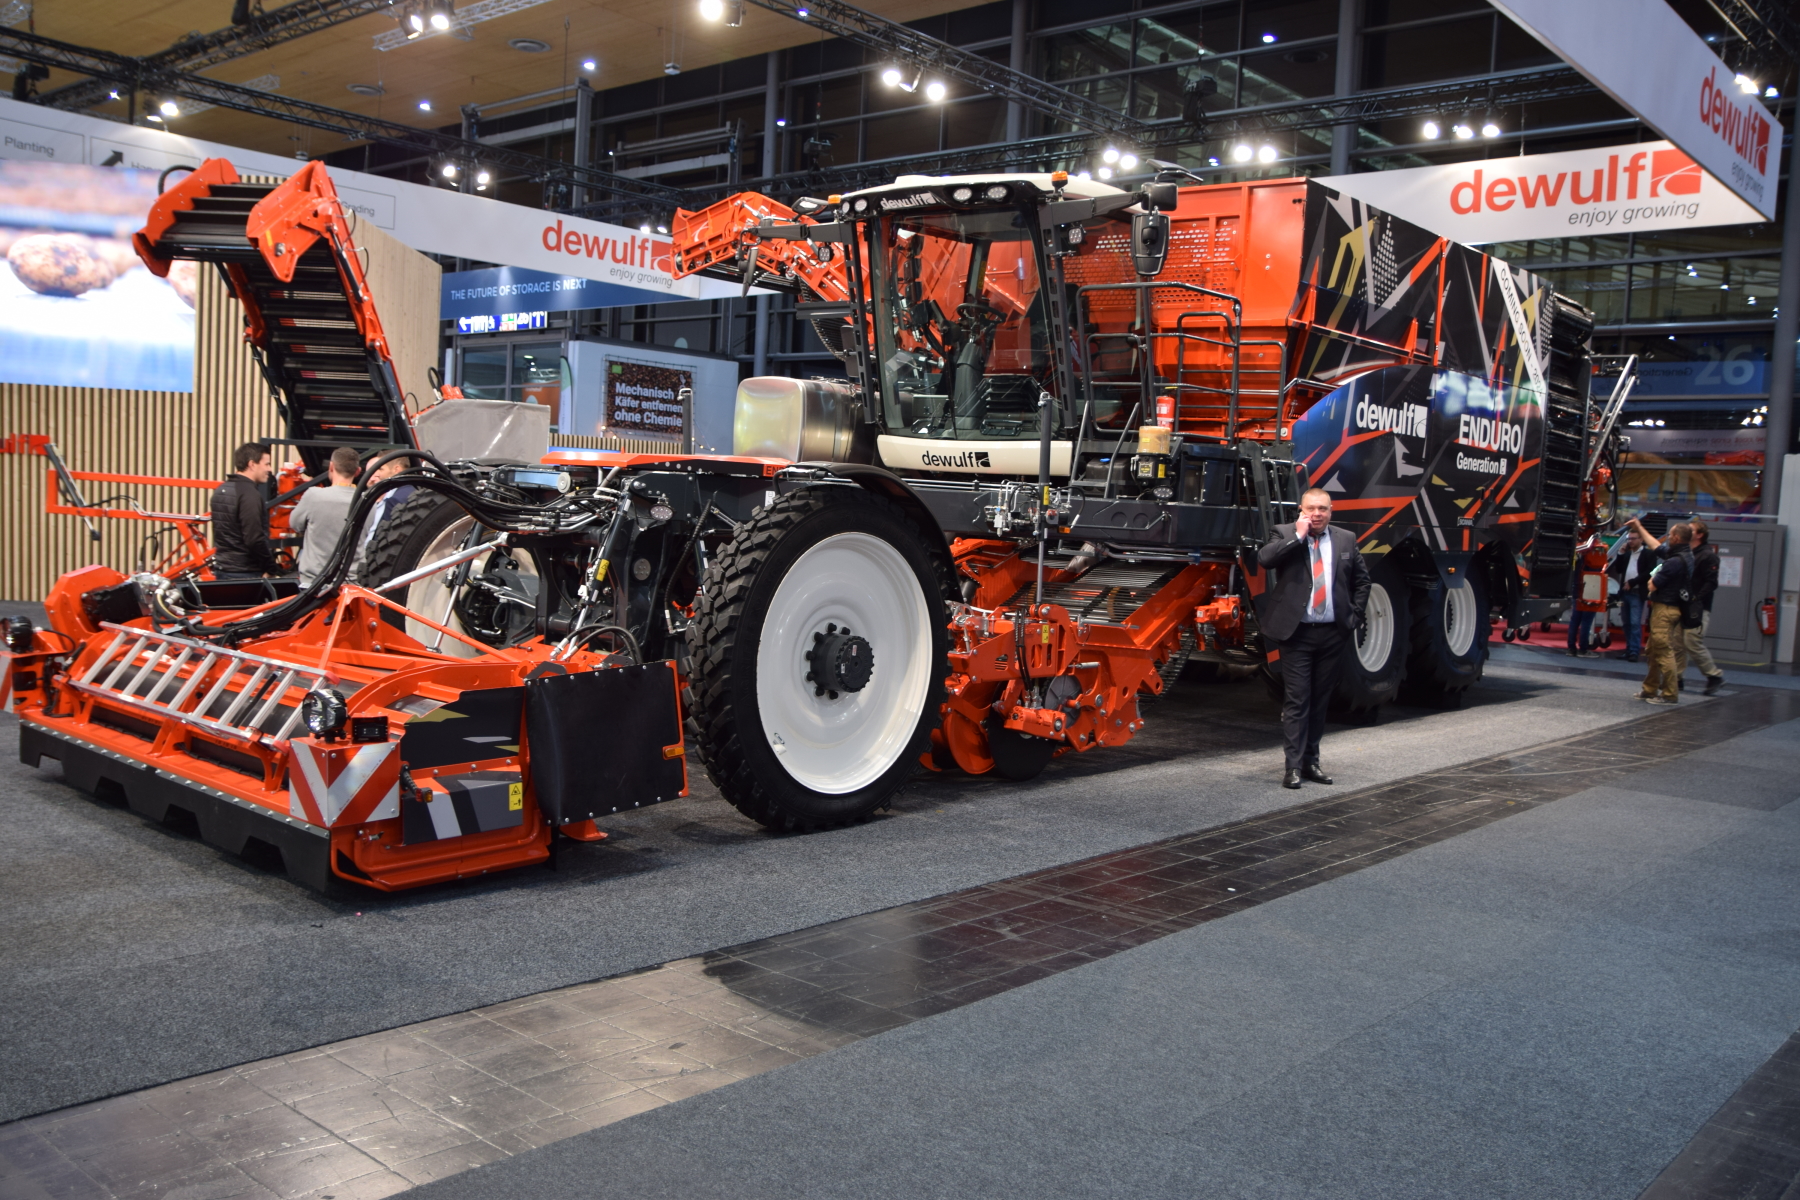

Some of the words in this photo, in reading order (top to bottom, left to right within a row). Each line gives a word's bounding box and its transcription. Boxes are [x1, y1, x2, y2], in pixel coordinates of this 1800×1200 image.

[1699, 65, 1760, 164] dewulf
[5, 135, 55, 158] Planting
[1450, 151, 1647, 215] dewulf
[880, 194, 922, 210] dewulf
[1568, 207, 1618, 227] enjoy
[1622, 201, 1700, 225] growing
[542, 219, 649, 268] dewulf
[451, 289, 466, 300] THE
[467, 286, 498, 299] FUTURE
[499, 284, 511, 297] OF
[512, 281, 550, 295] STORAGE
[552, 280, 561, 291] IS
[563, 278, 587, 290] NEXT
[609, 267, 636, 280] enjoy
[637, 271, 673, 289] growing
[1500, 268, 1521, 322] COMING
[1518, 322, 1532, 362] SOON
[1694, 344, 1755, 386] 26
[615, 382, 674, 400] Mechanisch
[615, 396, 640, 409] Käfer
[641, 400, 683, 414] entfernen
[1355, 393, 1415, 437] dewulf
[614, 408, 642, 423] ohne
[643, 411, 683, 427] Chemie
[1458, 413, 1522, 454] ENDURO
[922, 450, 974, 468] dewulf
[1456, 451, 1499, 473] Generation
